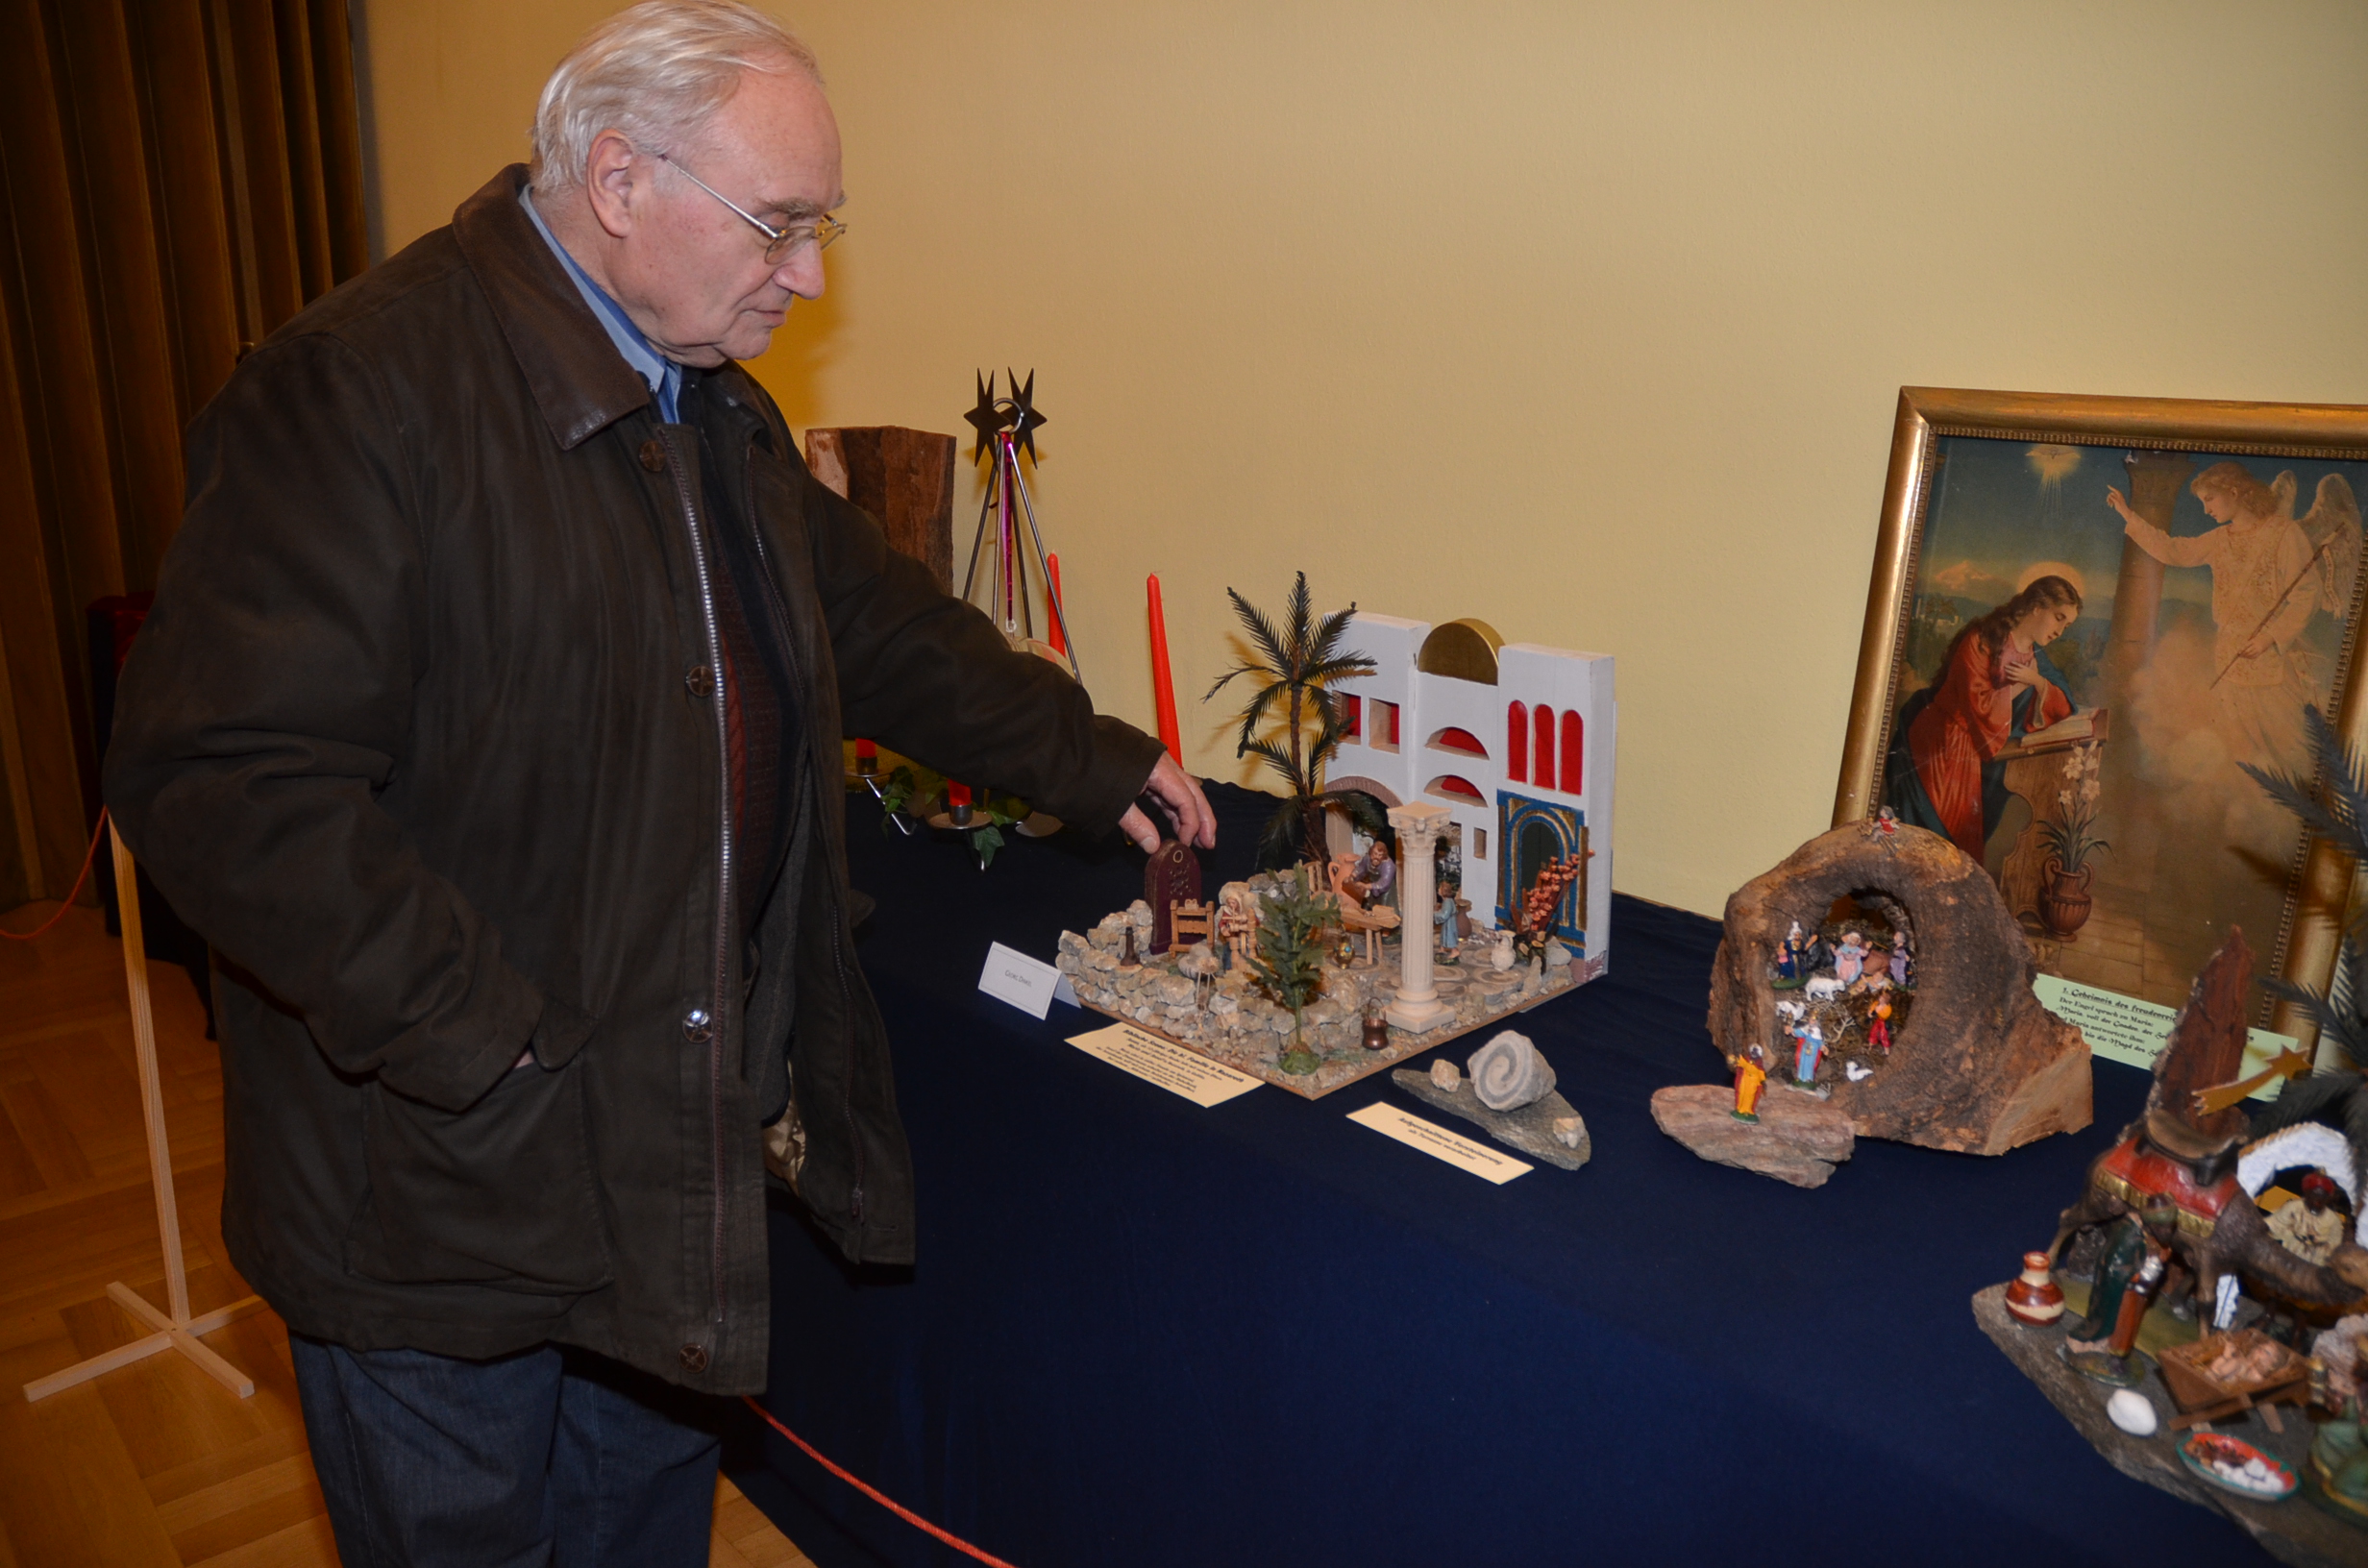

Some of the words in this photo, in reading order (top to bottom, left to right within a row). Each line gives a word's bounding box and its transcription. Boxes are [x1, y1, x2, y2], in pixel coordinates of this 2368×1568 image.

[2060, 996, 2073, 1005] Der
[2074, 1000, 2095, 1011] Engel
[2095, 1008, 2119, 1018] sprach
[2114, 1000, 2129, 1010] des
[2131, 1004, 2177, 1022] freudenreic
[2070, 1017, 2090, 1028] Maria
[2090, 1025, 2129, 1040] antwortete
